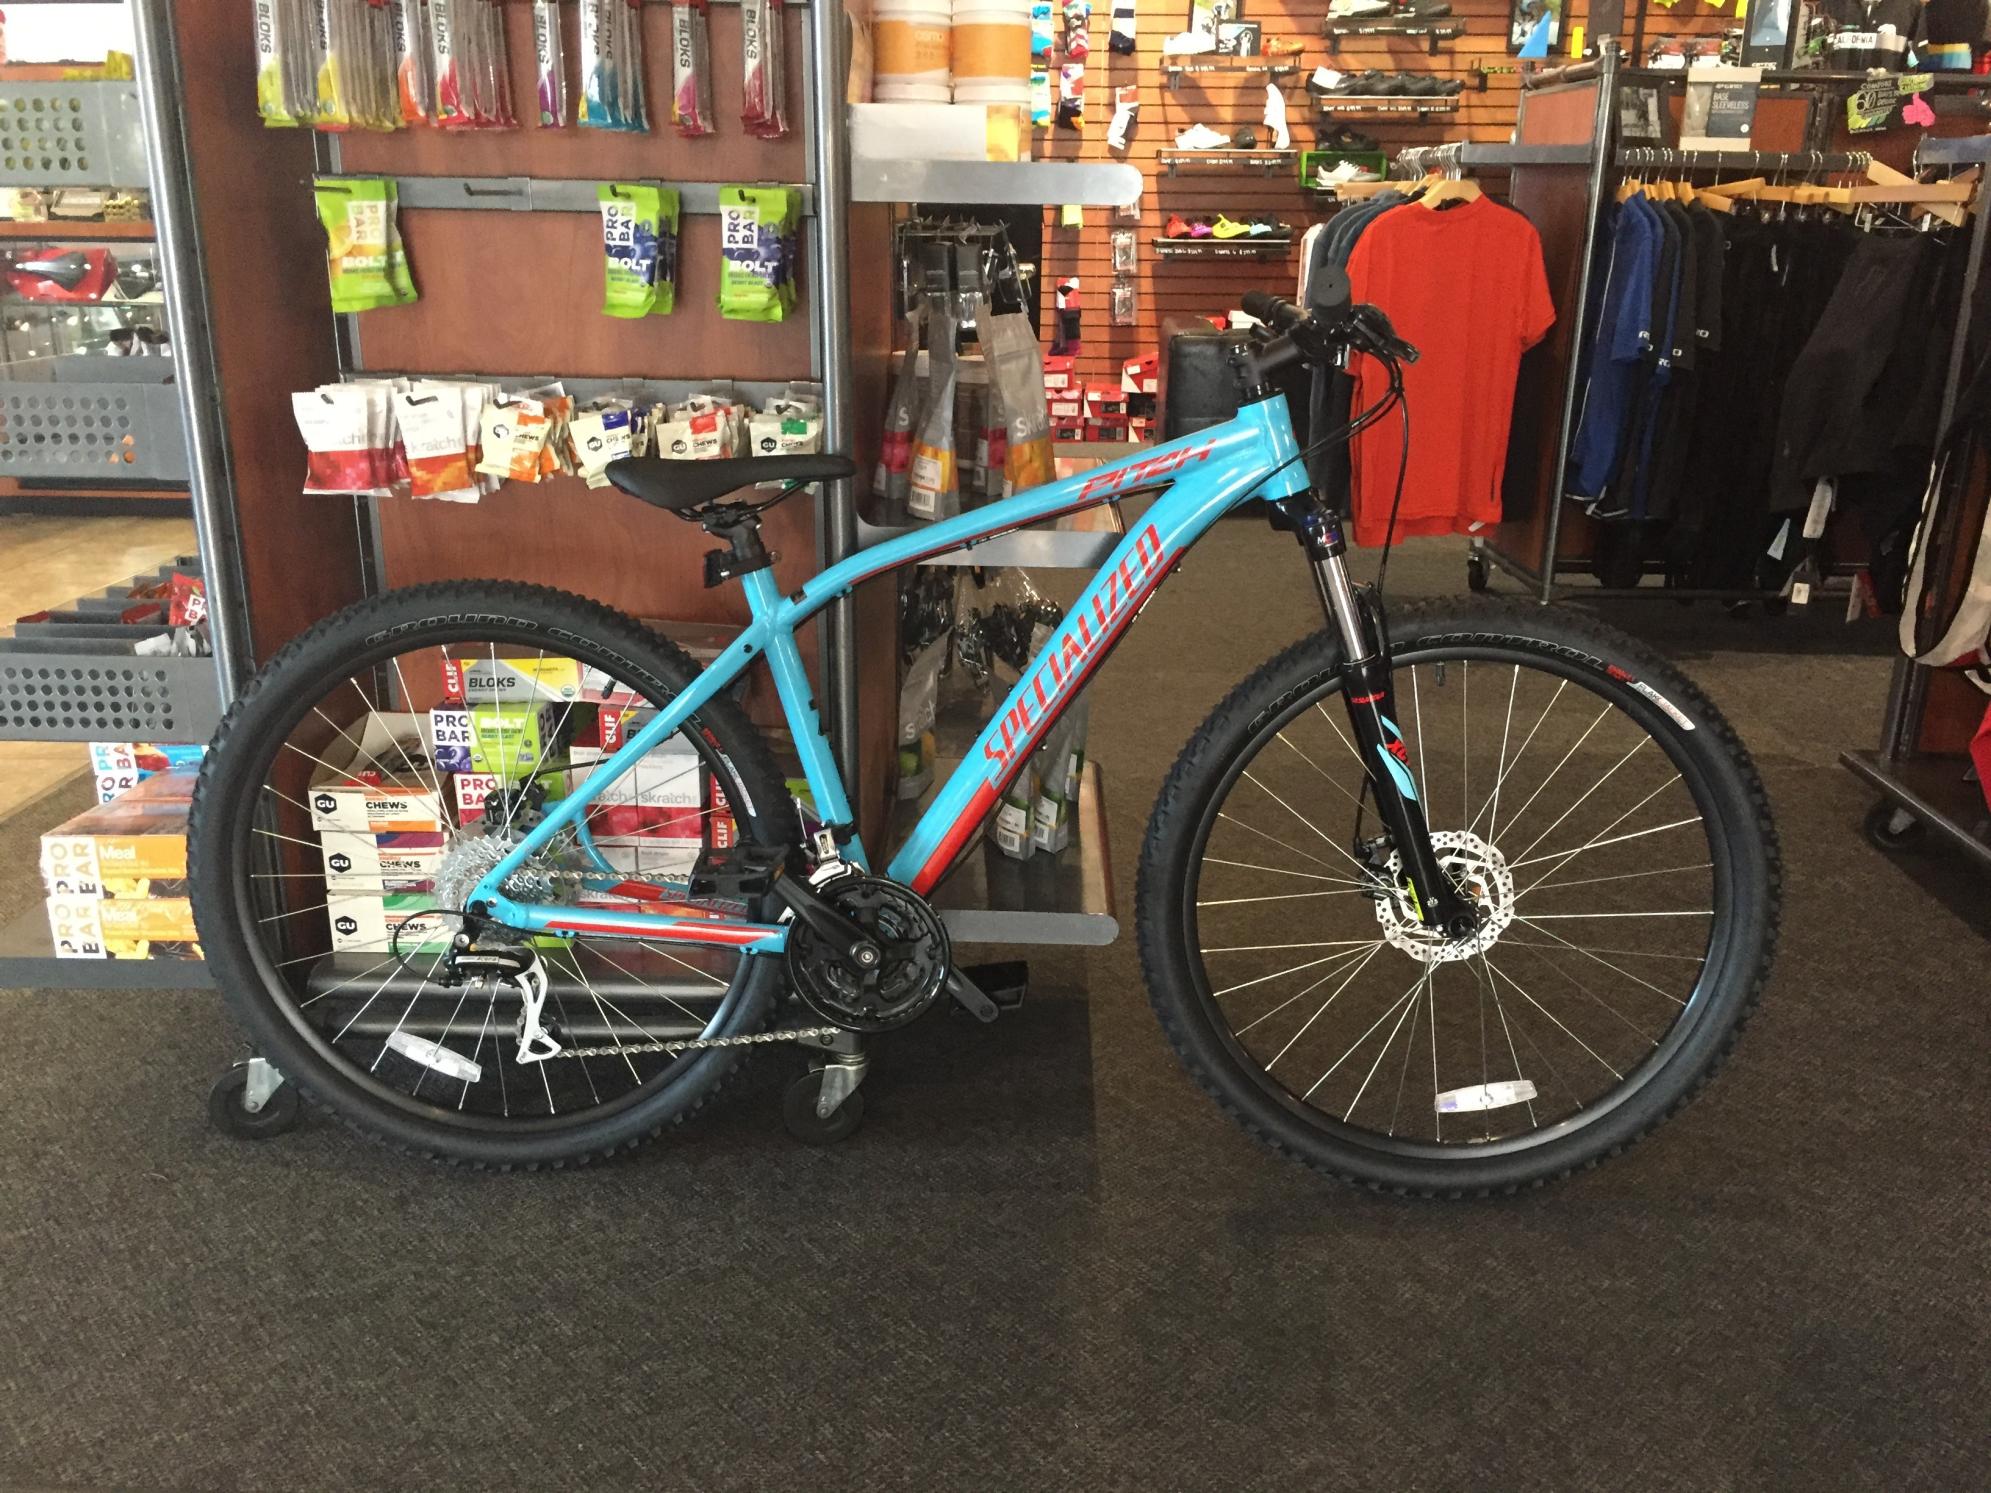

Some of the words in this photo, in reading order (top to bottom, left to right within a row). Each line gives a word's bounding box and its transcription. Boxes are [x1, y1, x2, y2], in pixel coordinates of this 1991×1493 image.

[257, 2, 272, 54] BLOKS
[434, 3, 449, 55] BLOKS
[746, 9, 757, 60] BLOKS
[536, 14, 549, 64] BLOKS
[678, 19, 691, 69] BLOKS
[1713, 92, 1729, 101] BASE
[1712, 101, 1750, 109] SLEEVELESS
[351, 204, 368, 240] BAR
[366, 204, 379, 240] PRO
[605, 205, 619, 242] PRO
[619, 204, 633, 242] BAR
[727, 209, 741, 244] PRO
[742, 208, 755, 245] BAR
[608, 257, 651, 272] BOLT
[729, 259, 779, 272] BOLT
[672, 443, 687, 451] GU
[692, 438, 718, 448] CHEWS
[762, 441, 775, 449] GU
[984, 523, 1164, 784] SPECIALIZED
[445, 663, 460, 693] CLIF
[469, 677, 515, 688] BLOKS
[434, 714, 469, 727] PRO
[480, 717, 525, 729] BOLT
[604, 714, 617, 743] CLIF
[436, 729, 470, 742] BAR
[461, 778, 496, 790] PRO
[317, 800, 335, 808] GU
[366, 801, 408, 809] CHEWS
[462, 793, 485, 806] BA
[717, 821, 728, 849] CLIF
[100, 844, 136, 860] Meal
[50, 843, 74, 894] PRO
[73, 843, 97, 894] BAR
[331, 859, 349, 867] GU
[380, 860, 421, 868] CHEWS
[54, 903, 79, 954] PRO
[76, 904, 100, 954] BAR
[336, 922, 356, 930] GU
[386, 923, 427, 931] CHEWS
